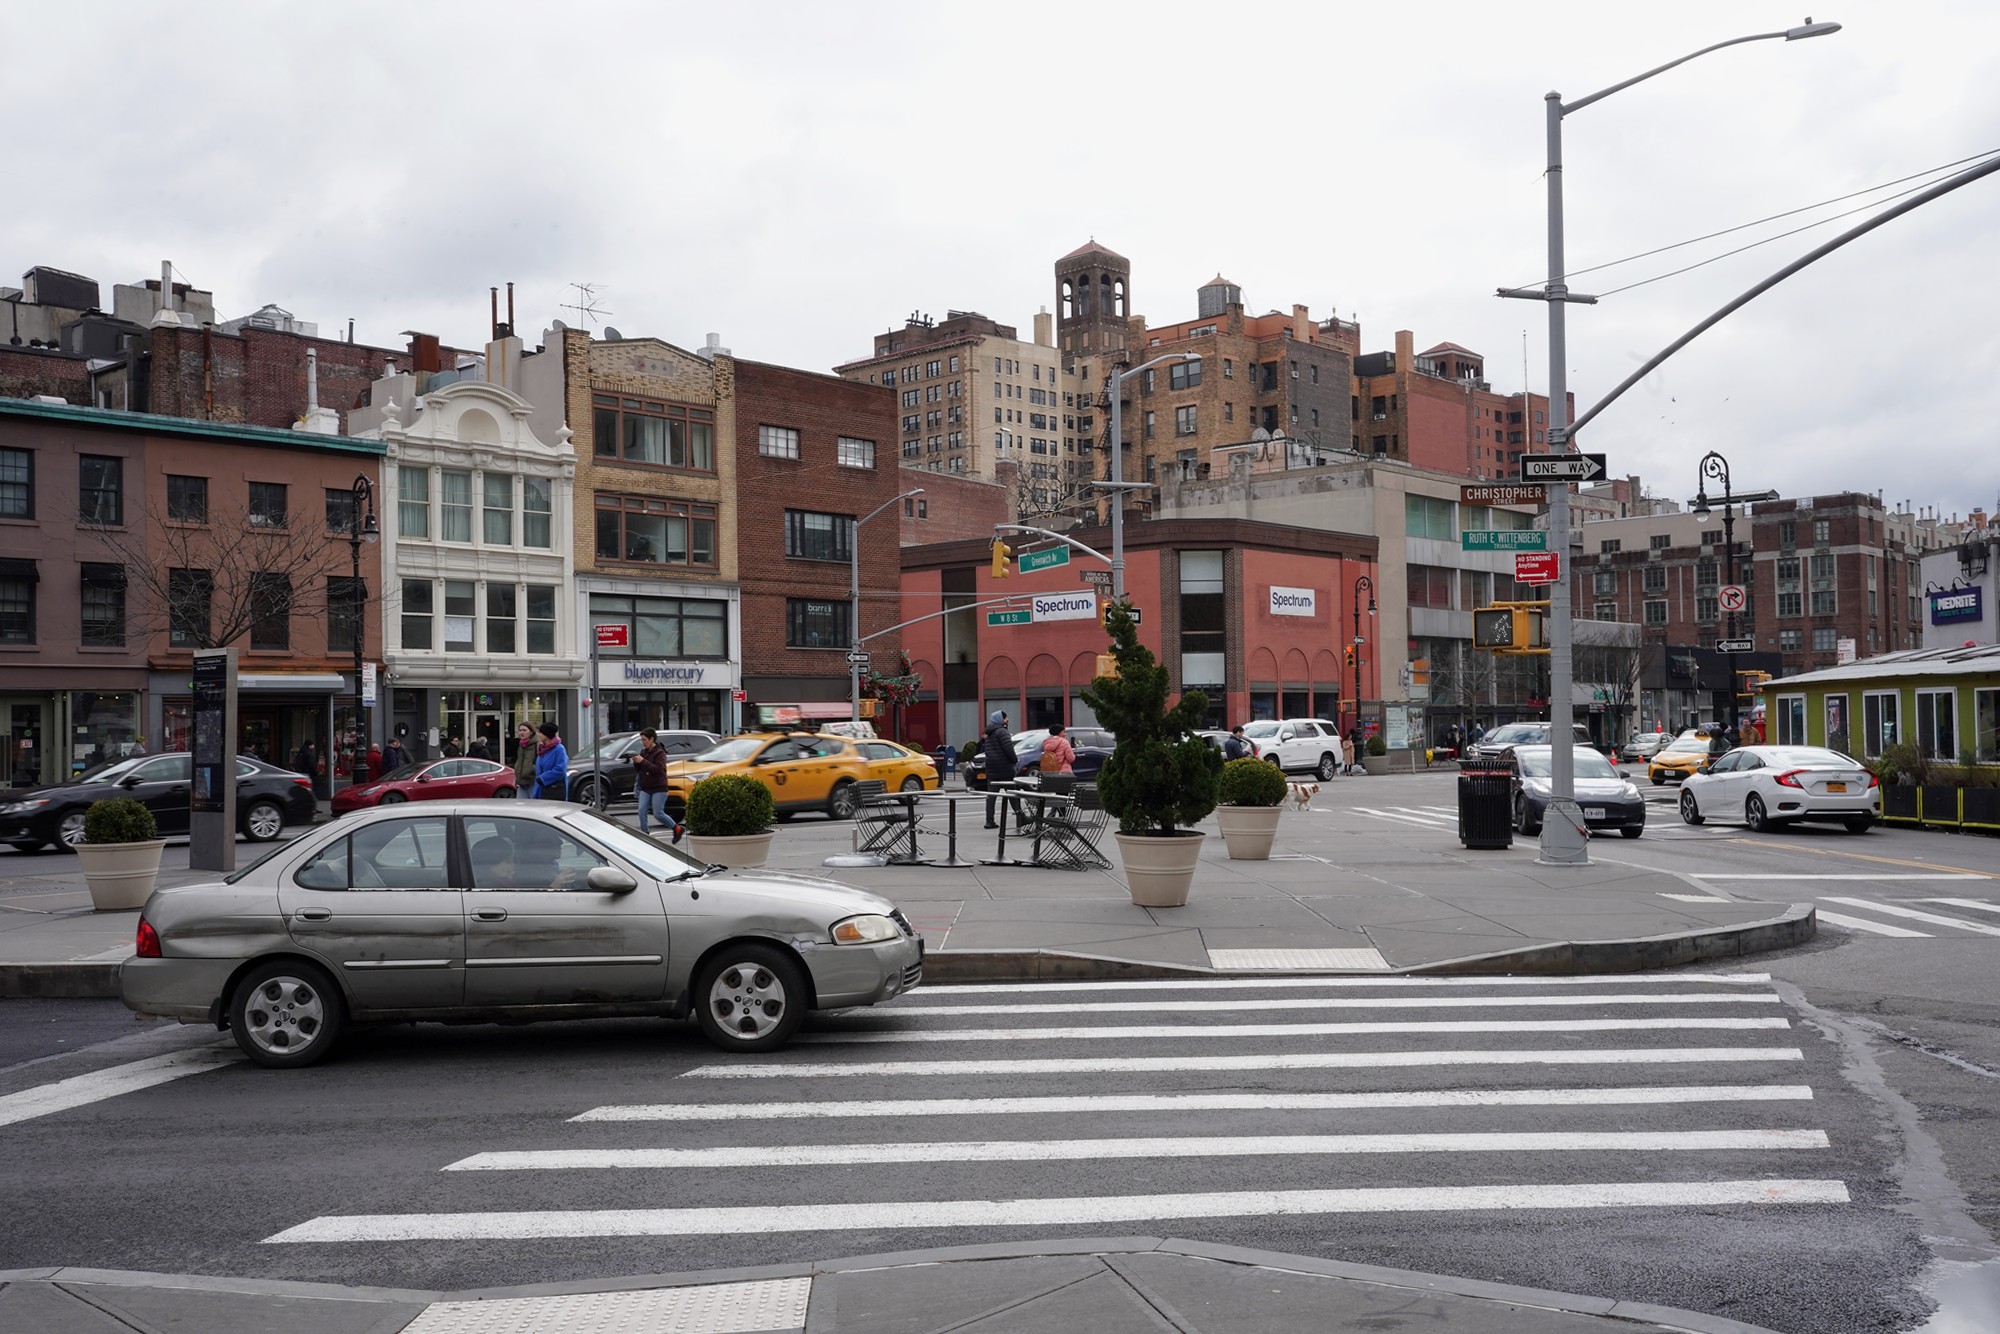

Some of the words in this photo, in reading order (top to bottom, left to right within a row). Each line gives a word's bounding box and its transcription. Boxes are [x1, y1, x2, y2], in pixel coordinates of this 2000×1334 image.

[1533, 463, 1557, 474] ONE
[1568, 462, 1593, 473] WAY
[1466, 486, 1542, 500] CHRISTOPHER
[1468, 532, 1488, 544] RUTH
[1490, 533, 1495, 544] E
[1497, 532, 1542, 544] WITTENBERG
[1031, 554, 1051, 568] Greenwich
[1051, 552, 1058, 563] Av
[1084, 575, 1110, 583] AMERICAS
[1097, 585, 1102, 595] 6
[1035, 598, 1089, 616] Spectrum
[1272, 592, 1310, 608] Spectrum
[1937, 594, 1977, 611] MEDRITE
[1012, 615, 1018, 623] St
[624, 663, 704, 683] bluemercury
